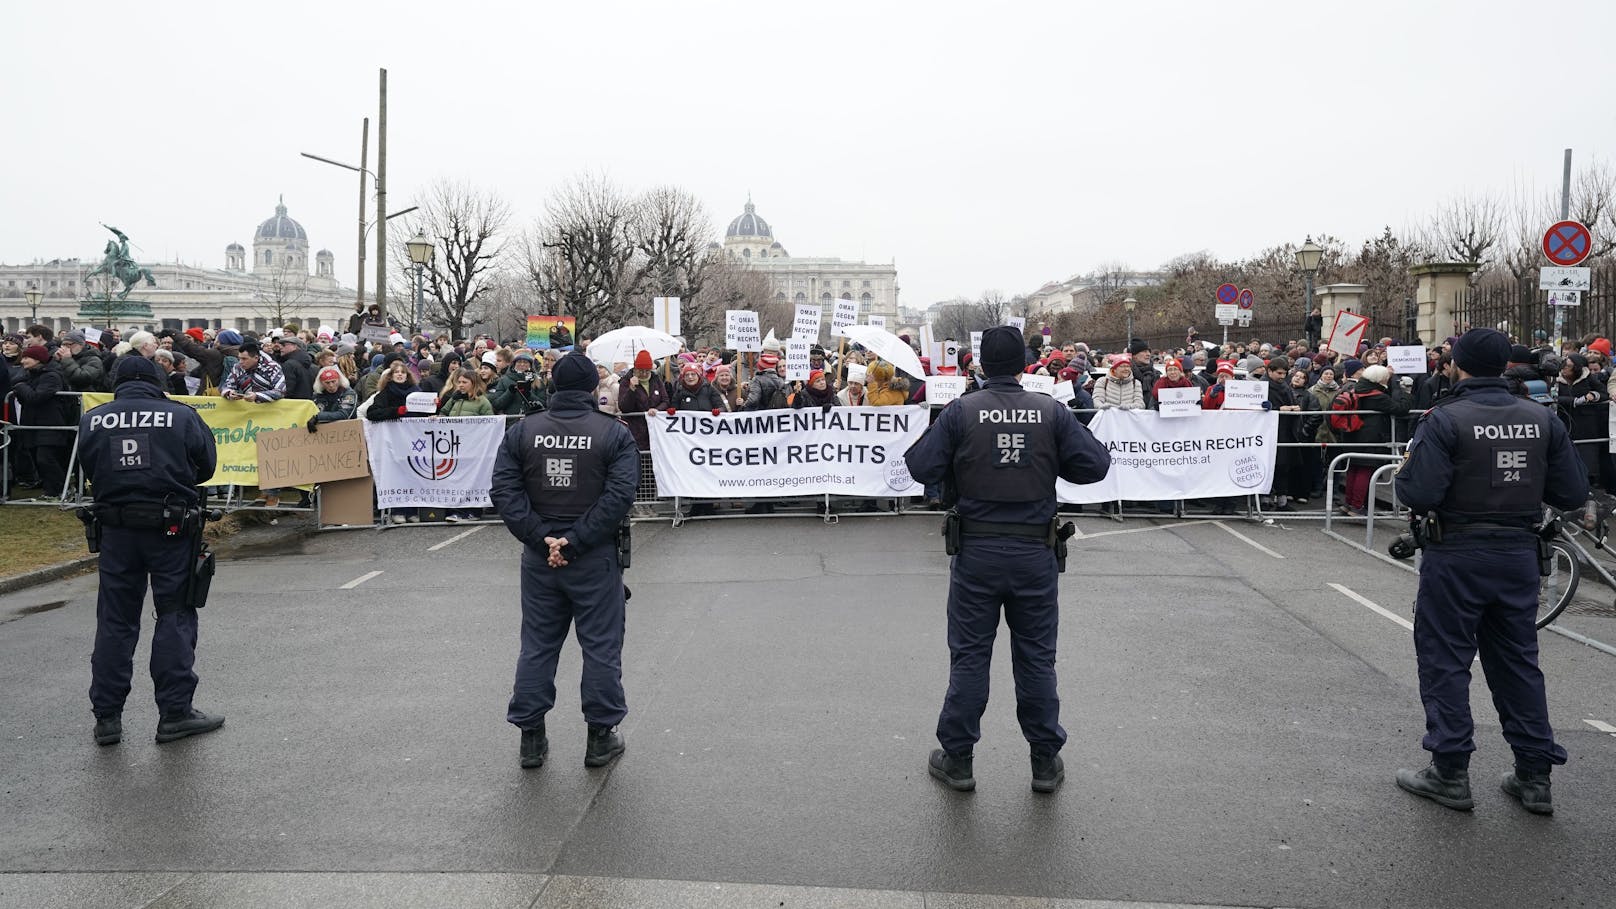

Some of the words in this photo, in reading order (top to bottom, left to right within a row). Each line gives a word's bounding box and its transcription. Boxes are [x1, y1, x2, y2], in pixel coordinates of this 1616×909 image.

[800, 309, 817, 317] OMAS
[838, 303, 855, 311] OMAS
[797, 318, 817, 326] GEGEN
[836, 312, 855, 321] GEGEN
[794, 327, 818, 335] RECHTS
[1227, 392, 1264, 400] GESCHICHTE
[90, 411, 173, 431] POLIZEI
[979, 409, 1042, 424] POLIZEI
[665, 412, 909, 436] ZUSAMMENHALTEN
[1473, 423, 1541, 440] POLIZEI
[122, 439, 138, 455] D
[534, 434, 592, 450] POLIZEI
[997, 433, 1025, 448] BE
[1151, 440, 1201, 453] GEGEN
[1205, 435, 1264, 451] RECHTS
[120, 455, 142, 466] 151
[308, 449, 363, 474] DANKE!
[688, 446, 778, 467] GEGEN
[787, 442, 886, 466] RECHTS
[1000, 449, 1020, 463] 24
[1110, 454, 1211, 468] omasgegenrechts.at
[1234, 455, 1257, 467] OMAS
[1496, 451, 1527, 469] BE
[546, 458, 573, 475] BE
[890, 468, 908, 476] GEGE
[1235, 464, 1260, 475] GEGEN
[548, 476, 571, 487] 120
[718, 474, 855, 490] www.omasgegenrechts.at
[1236, 472, 1263, 483] RECHTS
[1503, 470, 1521, 482] 24
